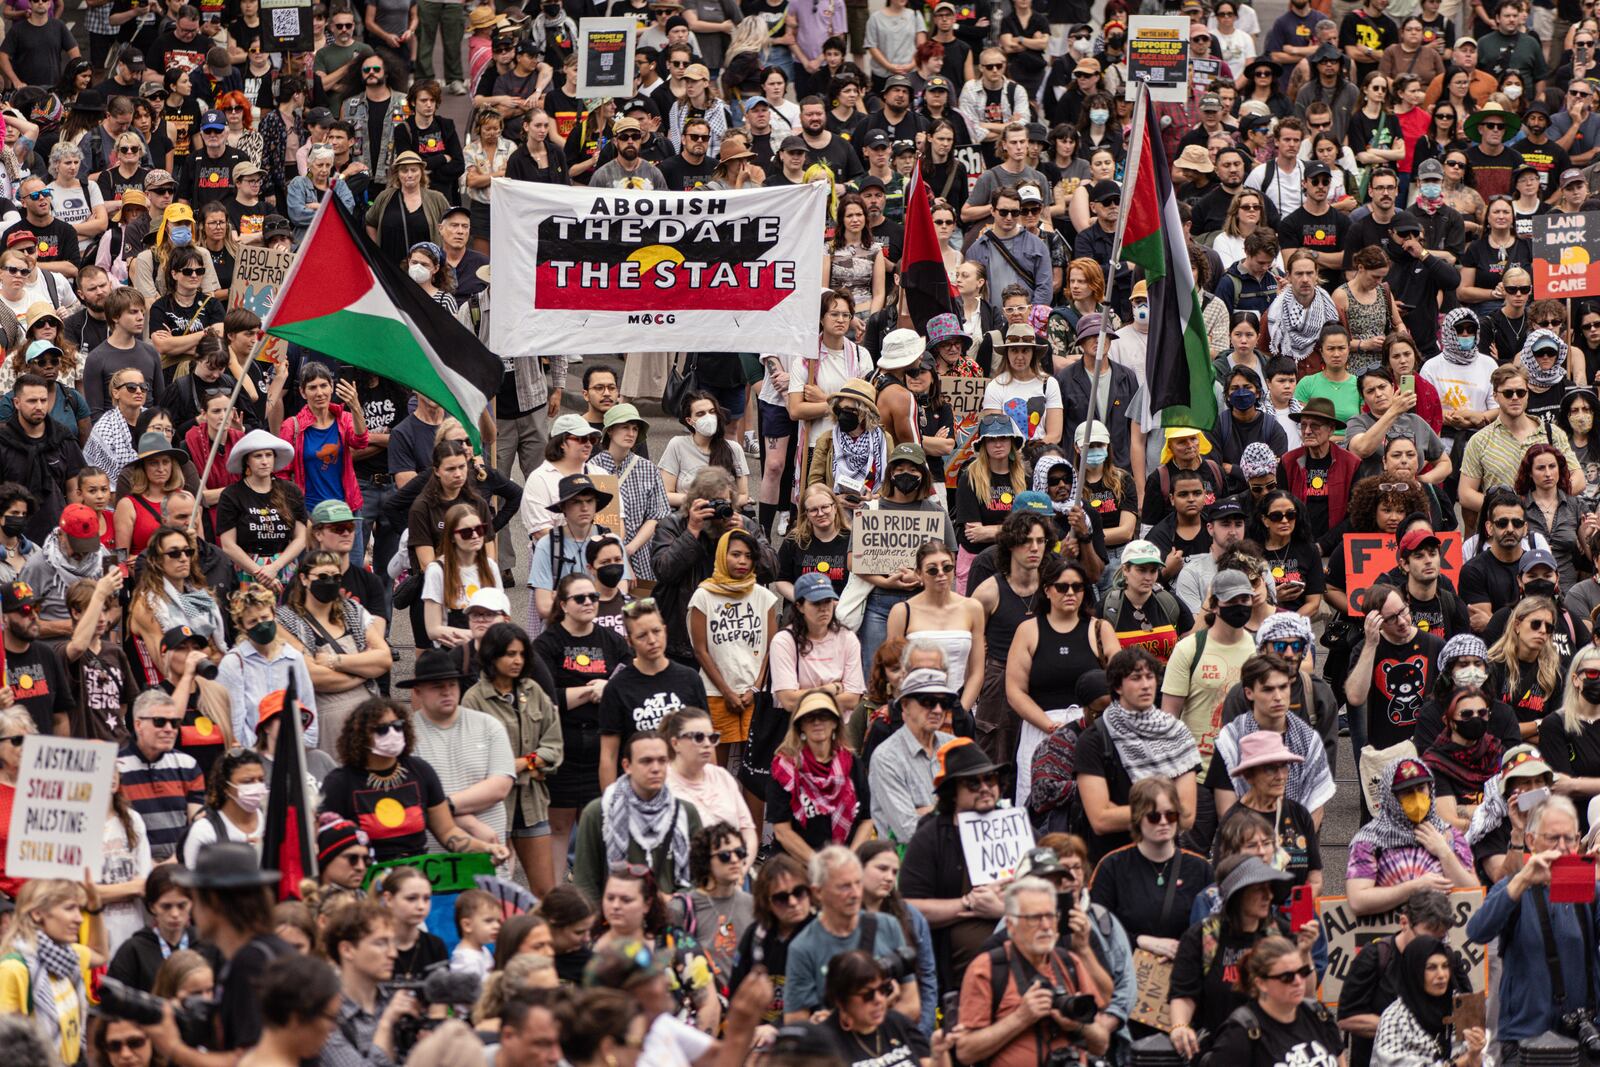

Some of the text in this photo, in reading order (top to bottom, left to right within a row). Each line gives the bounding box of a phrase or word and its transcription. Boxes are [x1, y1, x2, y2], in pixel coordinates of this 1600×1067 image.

[589, 196, 727, 217] ABOLISH
[553, 215, 781, 244] THE DATE
[1547, 215, 1586, 230] LAND
[1546, 230, 1587, 245] BACK
[239, 248, 294, 270] ABOLIS
[1560, 247, 1574, 260] IS
[549, 260, 796, 289] THE STATE
[1548, 262, 1587, 277] LAND
[1547, 278, 1587, 294] CARE
[259, 514, 280, 523] past
[861, 515, 940, 533] NO PRIDE IN
[257, 531, 286, 540] future
[861, 532, 929, 549] GENOCIDE
[861, 557, 891, 567] ALWAYS
[863, 548, 908, 560] anywhere,
[720, 602, 742, 619] NOT
[710, 618, 744, 633] DATE
[1202, 664, 1218, 672] IT'S
[1202, 672, 1220, 680] ACE
[27, 778, 93, 803] STOLEN LAND
[25, 807, 88, 835] PALESTINE:
[965, 811, 1029, 842] TREATY
[57, 844, 82, 866] LAND
[981, 840, 1019, 872] NOW
